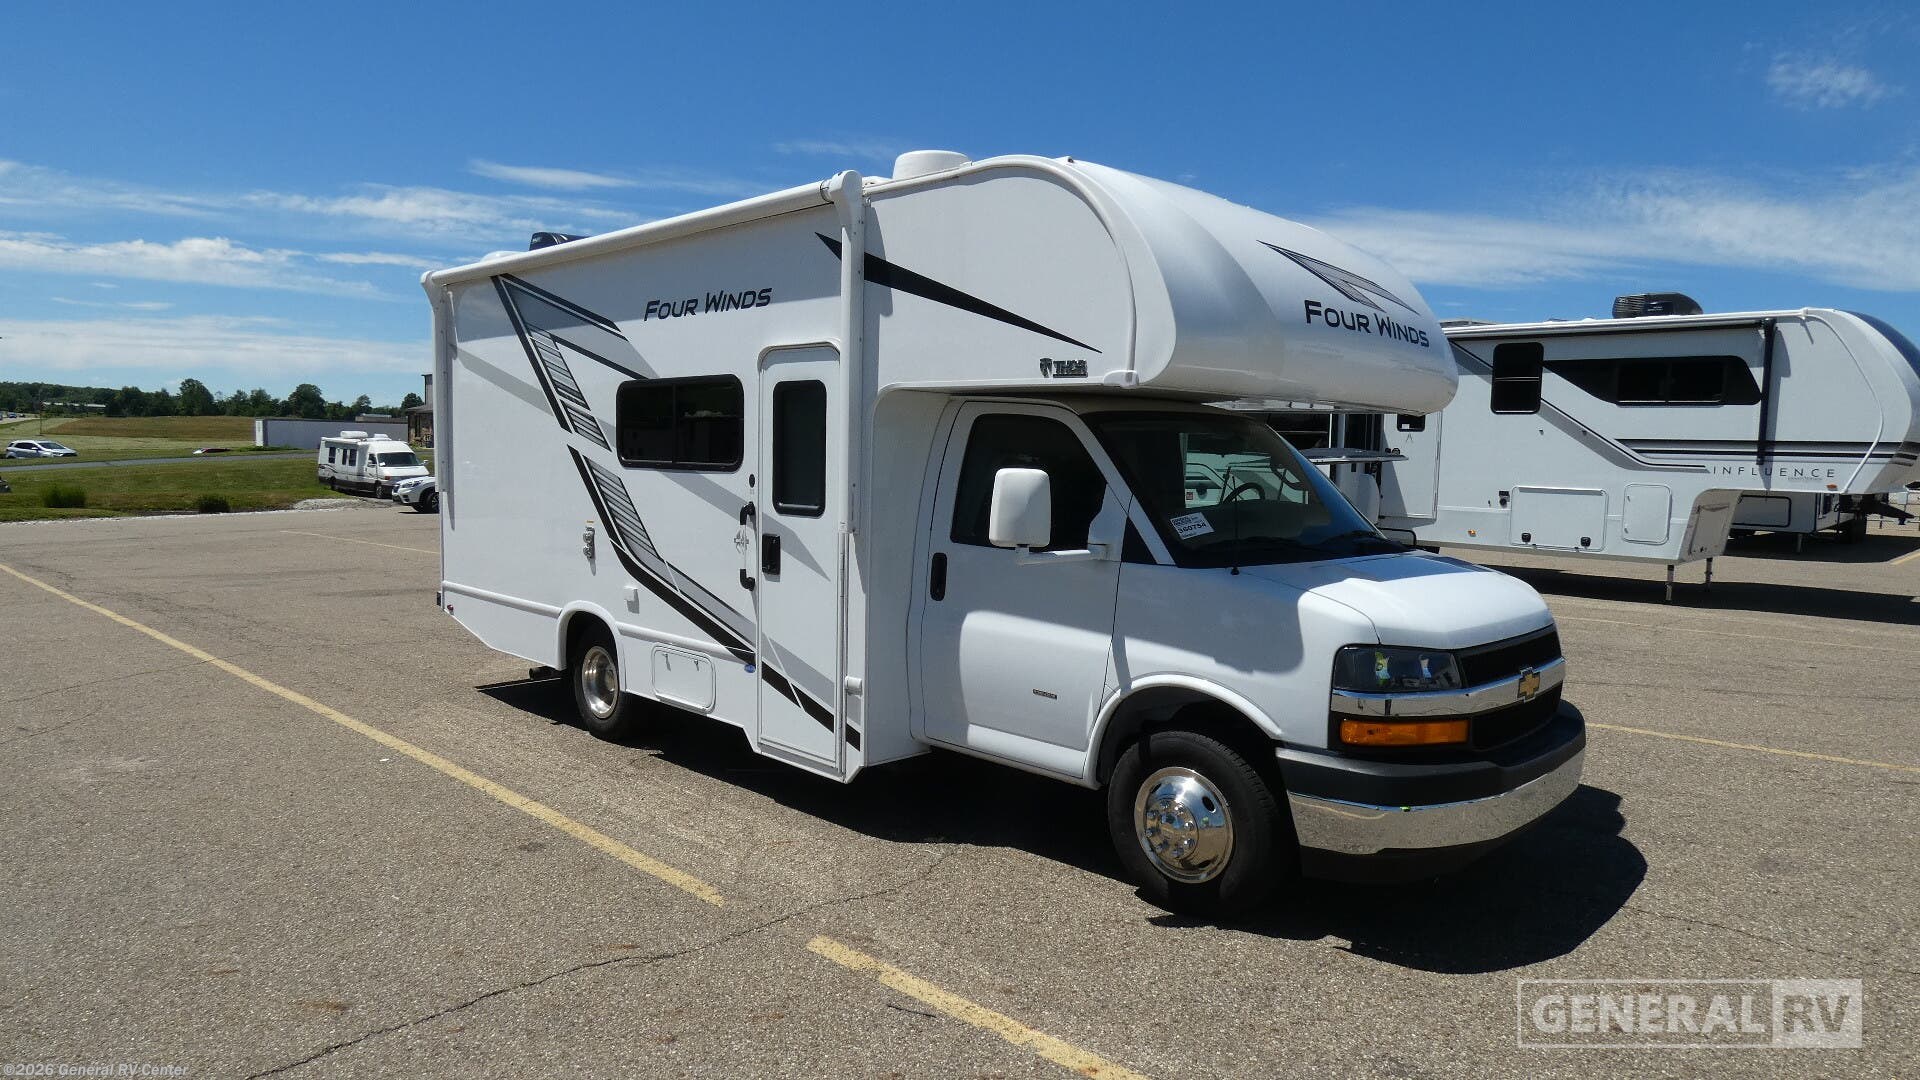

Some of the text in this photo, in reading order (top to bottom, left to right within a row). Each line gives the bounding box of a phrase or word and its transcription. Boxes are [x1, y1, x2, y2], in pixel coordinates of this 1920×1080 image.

[643, 287, 772, 321] FOUR WINDS
[1304, 300, 1430, 347] FOUR WINDS
[1712, 466, 1835, 478] INFLUENCE
